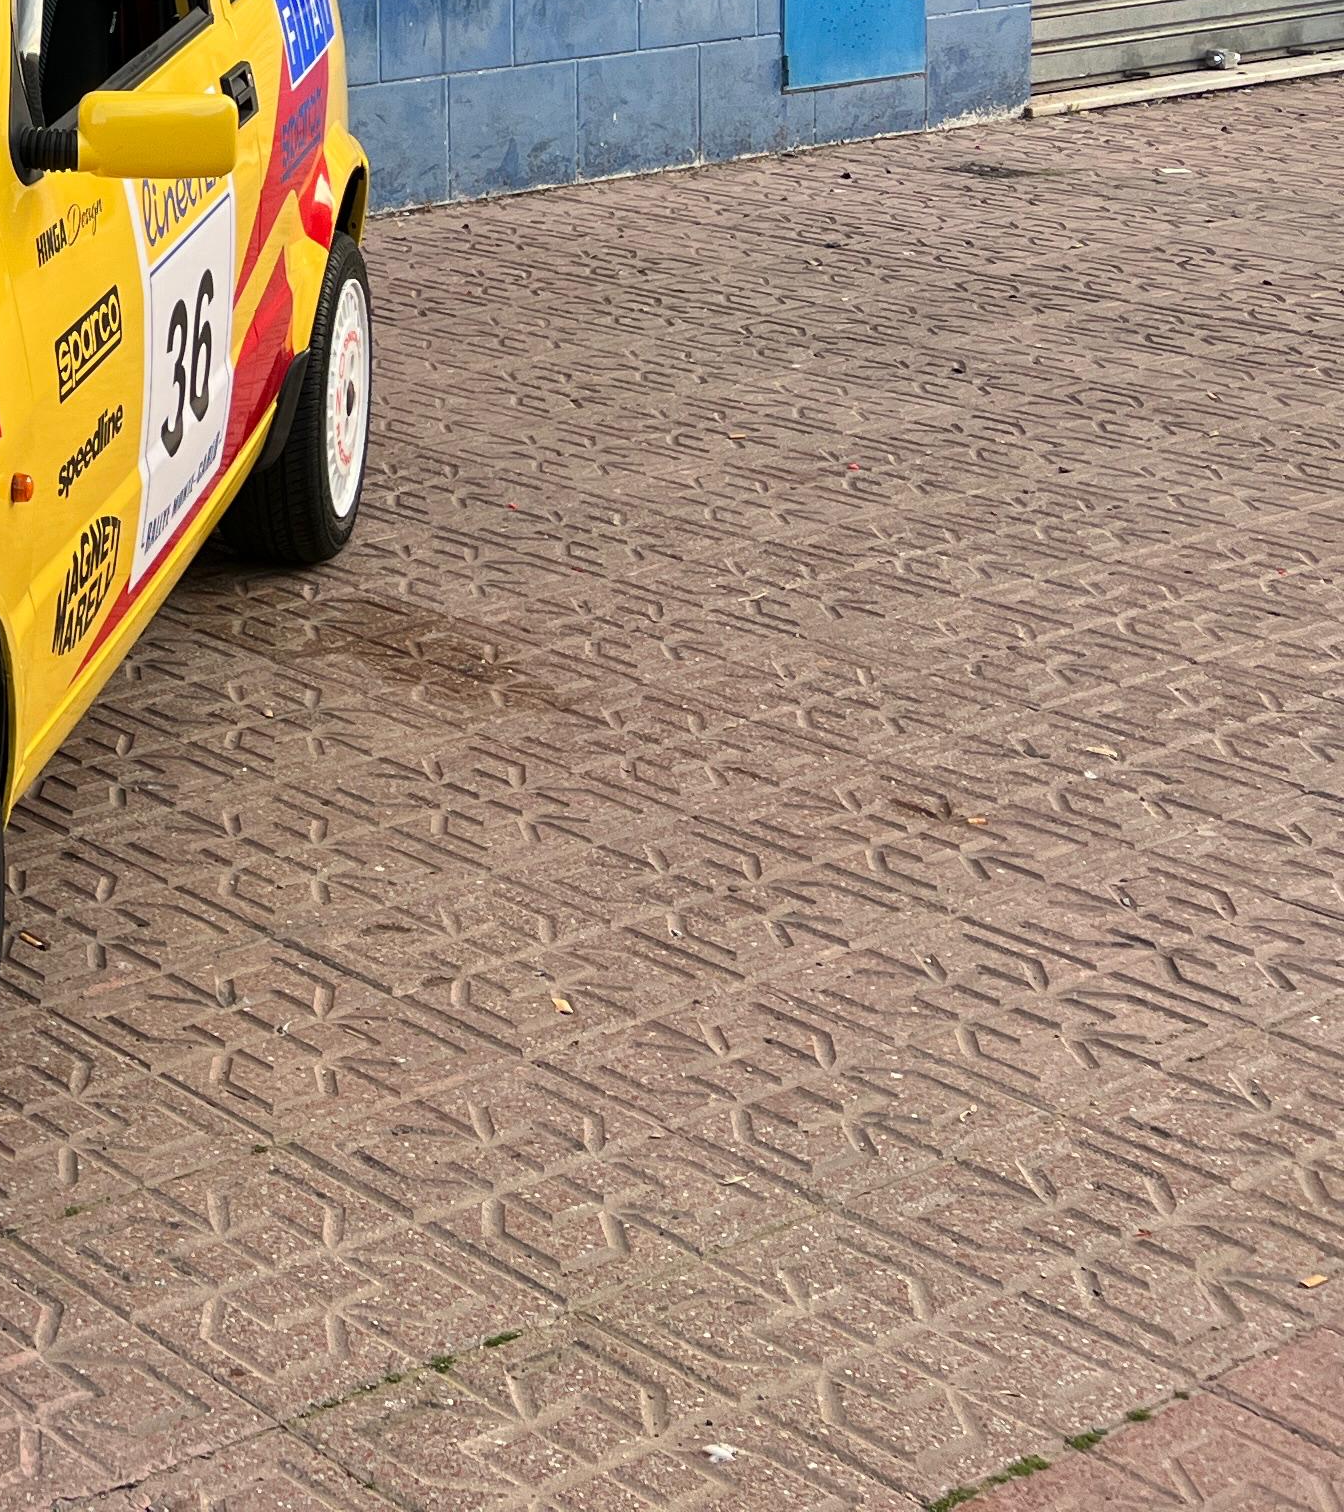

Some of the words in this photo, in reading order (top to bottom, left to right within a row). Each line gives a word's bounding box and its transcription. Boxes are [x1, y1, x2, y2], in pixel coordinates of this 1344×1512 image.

[58, 294, 121, 380] sparco
[160, 268, 215, 459] 36
[57, 404, 123, 499] speedline
